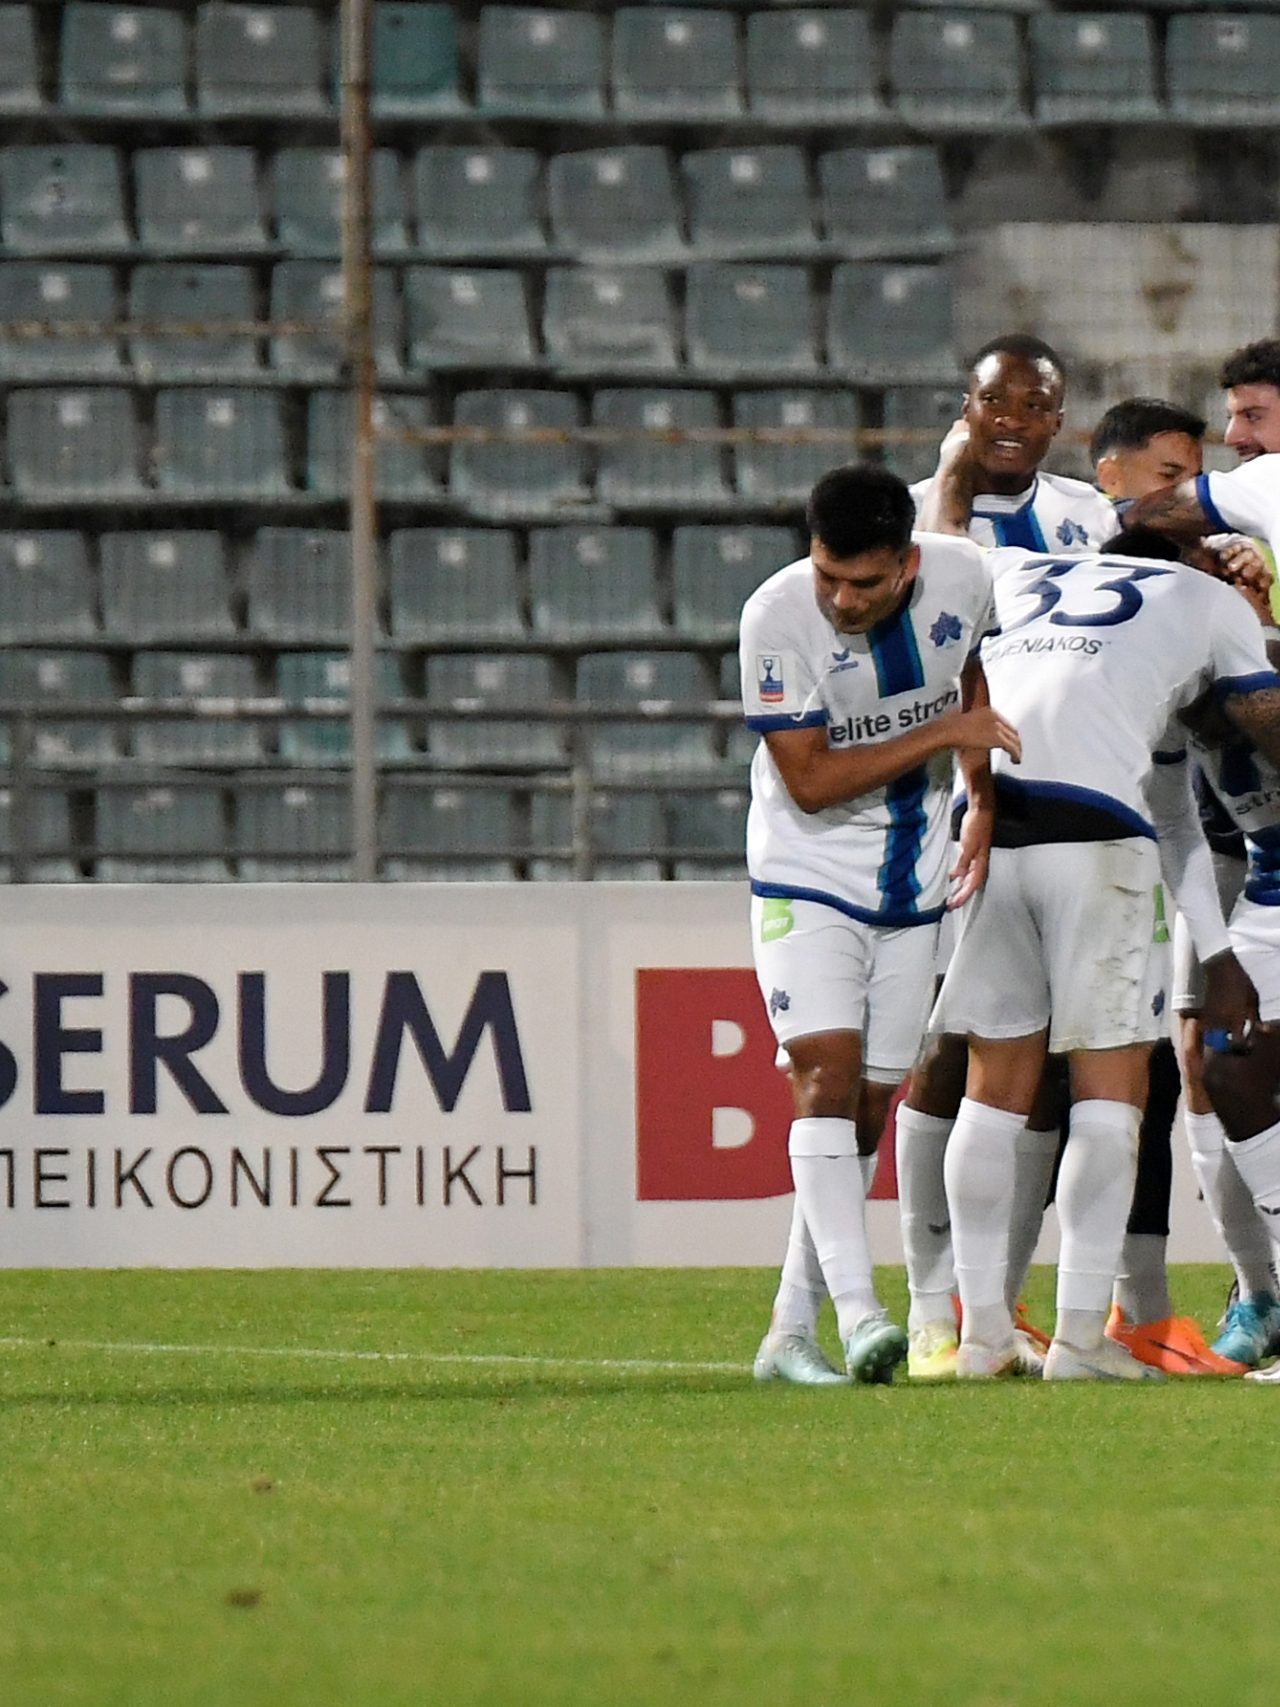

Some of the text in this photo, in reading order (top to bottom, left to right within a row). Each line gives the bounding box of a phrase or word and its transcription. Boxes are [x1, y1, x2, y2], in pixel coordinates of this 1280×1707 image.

[1003, 558, 1178, 634] 33
[829, 713, 891, 743] elite
[0, 970, 532, 1116] ERUM
